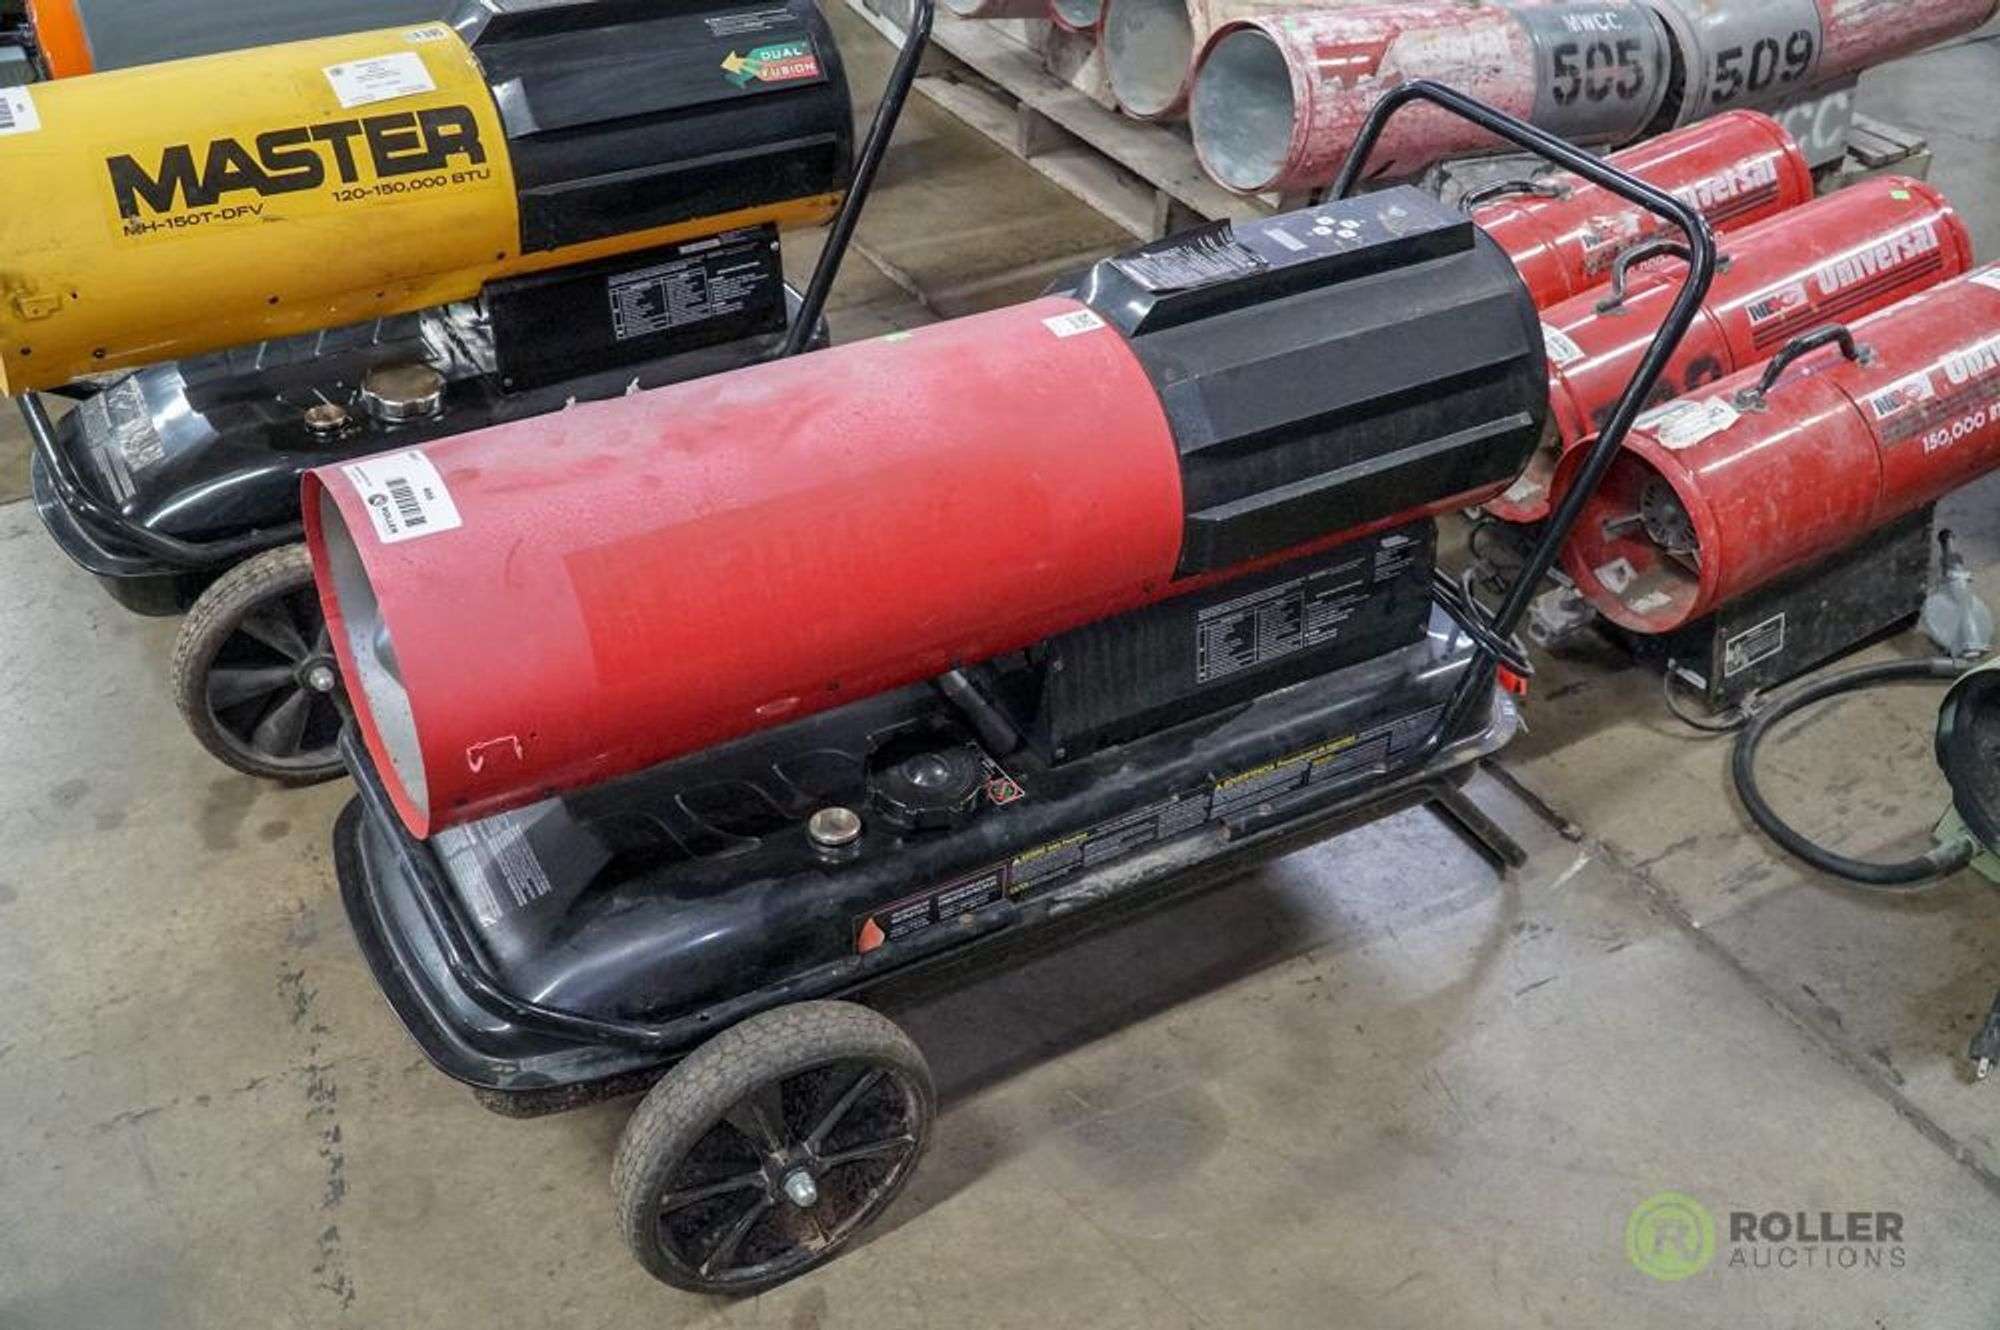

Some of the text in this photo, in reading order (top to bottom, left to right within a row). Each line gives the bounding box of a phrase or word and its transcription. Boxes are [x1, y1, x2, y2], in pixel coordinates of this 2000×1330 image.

[760, 46, 802, 60] DUAL
[1552, 40, 1645, 105] 505
[1711, 29, 1813, 101] 509
[106, 104, 487, 219] MASTER
[331, 168, 491, 203] 120-150,000 BTU
[1815, 223, 1939, 295] Universal
[1923, 410, 1986, 456] 150,000
